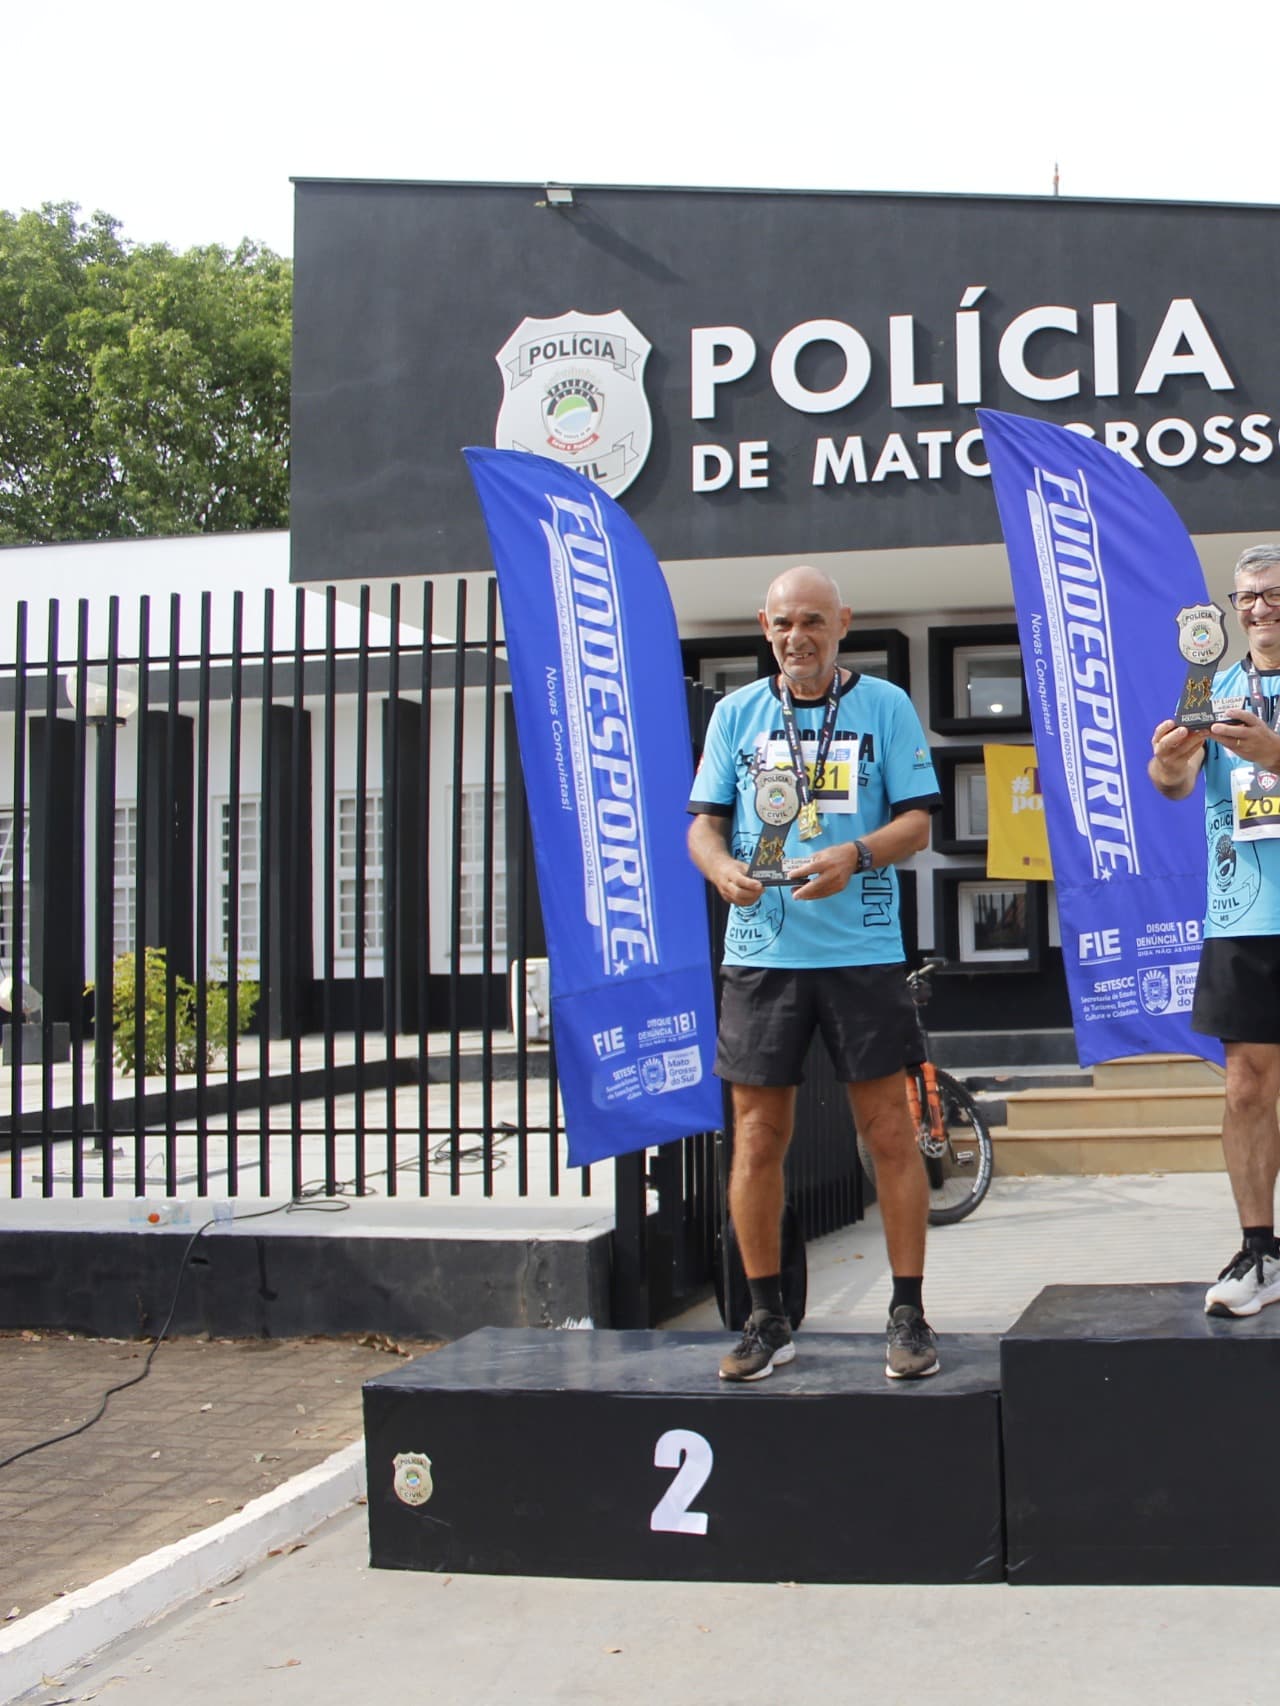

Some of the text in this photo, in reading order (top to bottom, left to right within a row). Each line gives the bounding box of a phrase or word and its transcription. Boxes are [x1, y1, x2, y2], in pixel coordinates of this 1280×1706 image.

[529, 334, 616, 364] POLÍCIA
[691, 286, 1235, 419] POLÍCIA
[692, 441, 768, 492] DE
[812, 431, 992, 485] MATO
[1192, 649, 1214, 658] CIVIL
[1031, 613, 1054, 736] Novas Conquistas!
[1041, 469, 1133, 874] FUNDESPORTE
[552, 495, 650, 964] FUNDESPORTE
[1060, 703, 1070, 728] MATO
[545, 666, 572, 811] Novas Conquistas!
[575, 771, 587, 801] MATO
[579, 803, 591, 848] GROSSO
[1212, 896, 1240, 910] CIVIL
[729, 928, 763, 940] CIVIL
[1079, 928, 1121, 960] FIE
[1136, 933, 1177, 948] DENÚNCIA
[1147, 920, 1205, 944] DISQUE 18
[1094, 976, 1135, 993] SETESCC
[1177, 998, 1191, 1007] do
[673, 1010, 697, 1034] 181
[593, 1026, 625, 1056] FIE
[651, 1429, 714, 1535] 2
